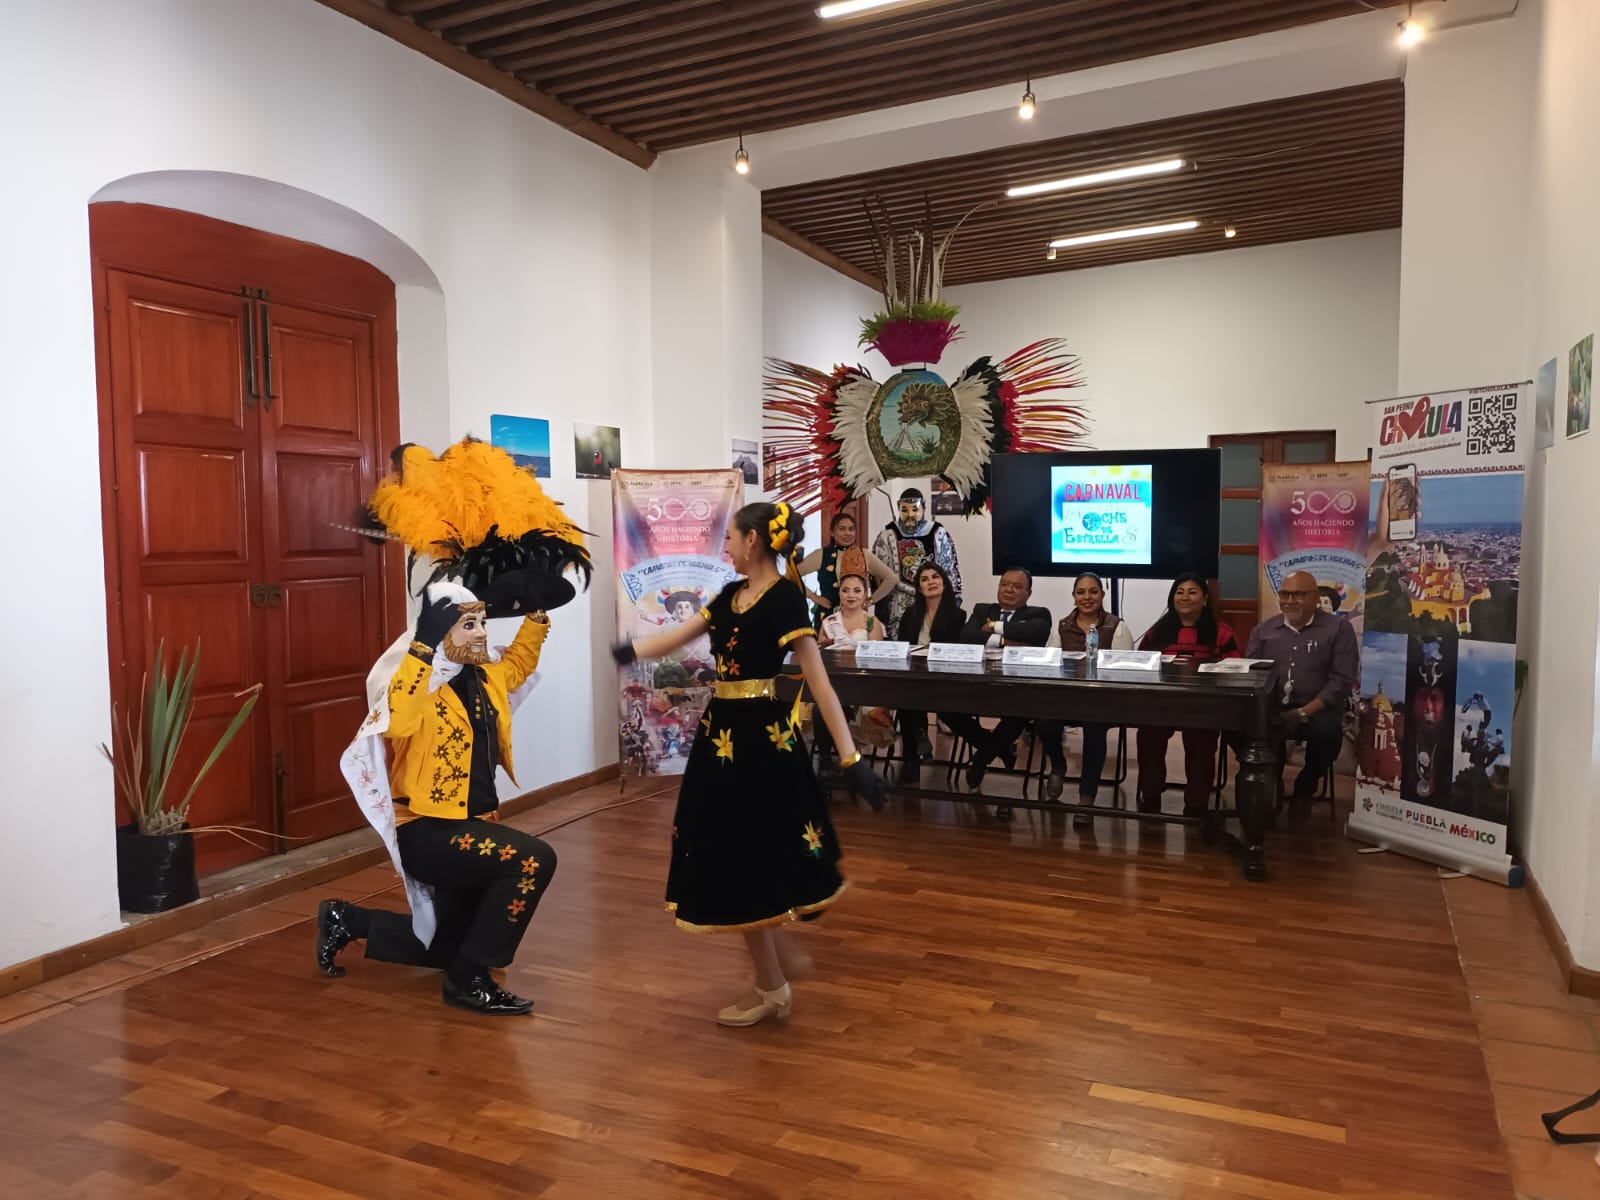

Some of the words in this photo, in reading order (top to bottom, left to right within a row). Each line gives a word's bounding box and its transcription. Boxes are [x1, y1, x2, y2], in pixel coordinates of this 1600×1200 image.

[1384, 405, 1395, 415] SAN
[1396, 401, 1415, 412] PEDRO
[1065, 483, 1141, 501] CARNAVAL
[1292, 518, 1313, 527] AÑOS
[1314, 519, 1355, 527] HACIENDO
[650, 524, 670, 534] AÑOS
[671, 525, 711, 533] HACIENDO
[1304, 528, 1341, 536] HISTORIA
[662, 534, 699, 542] HISTORIA
[1406, 810, 1447, 829] PUEBLA
